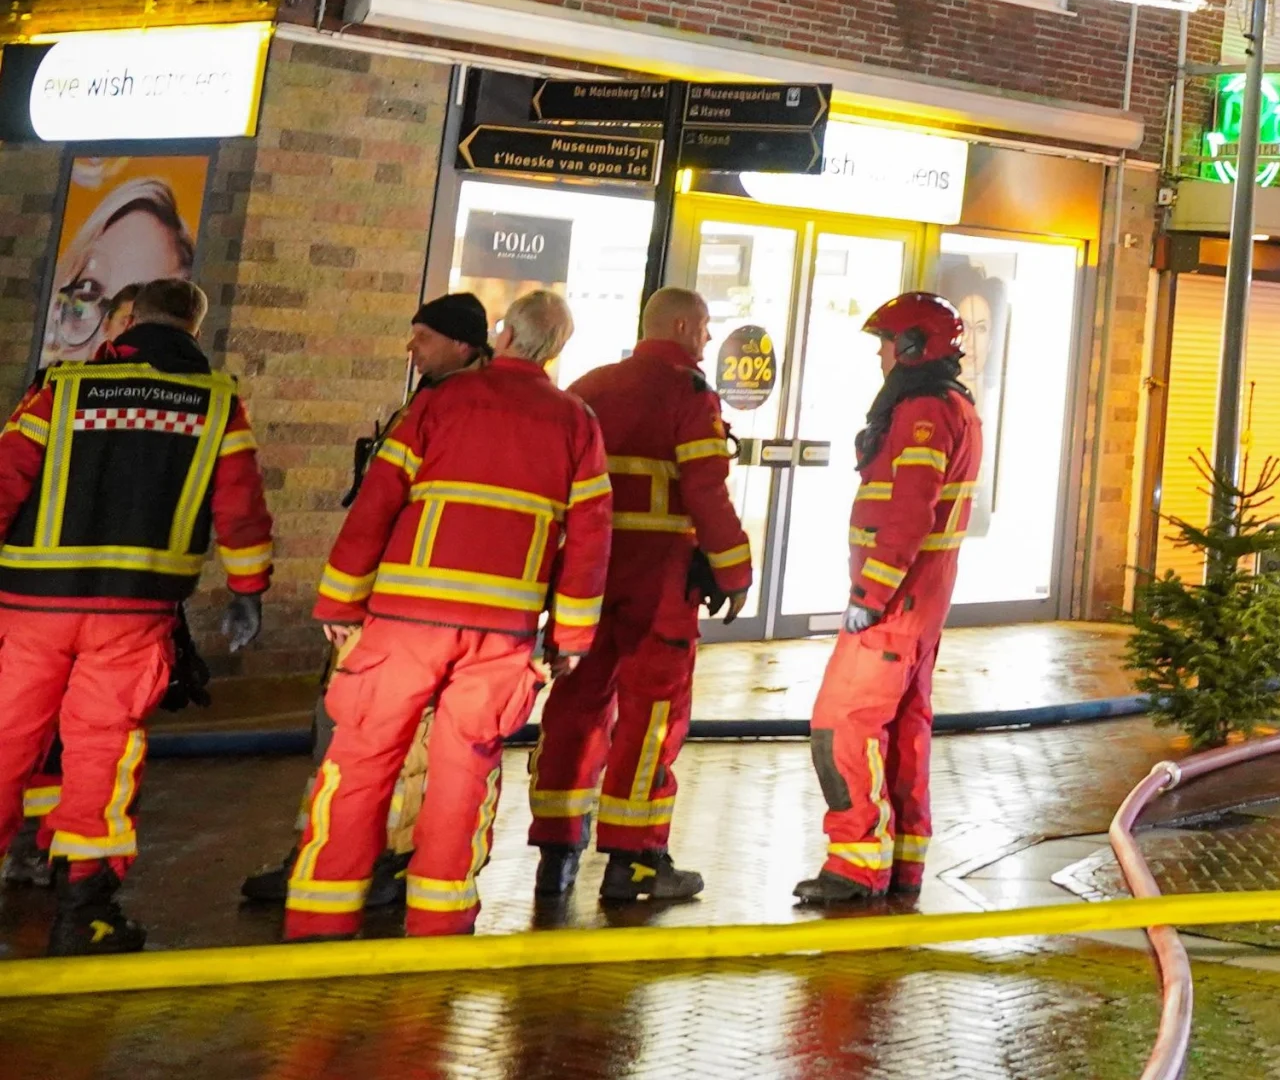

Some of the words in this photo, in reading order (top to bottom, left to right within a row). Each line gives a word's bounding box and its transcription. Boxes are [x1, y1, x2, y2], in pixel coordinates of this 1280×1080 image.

[43, 77, 80, 98] eye
[87, 68, 134, 96] wish
[574, 86, 585, 97] De
[589, 86, 638, 100] Molenberg
[699, 105, 731, 117] Haven
[551, 138, 649, 159] Museumhuisje
[698, 133, 731, 145] Strand
[494, 152, 555, 169] t'Hoeske
[559, 159, 583, 170] van
[588, 161, 622, 175] opoe
[627, 164, 648, 177] Iet
[493, 231, 545, 254] POLO
[722, 355, 772, 382] 20%
[87, 386, 203, 405] Aspirant/Stagiair
